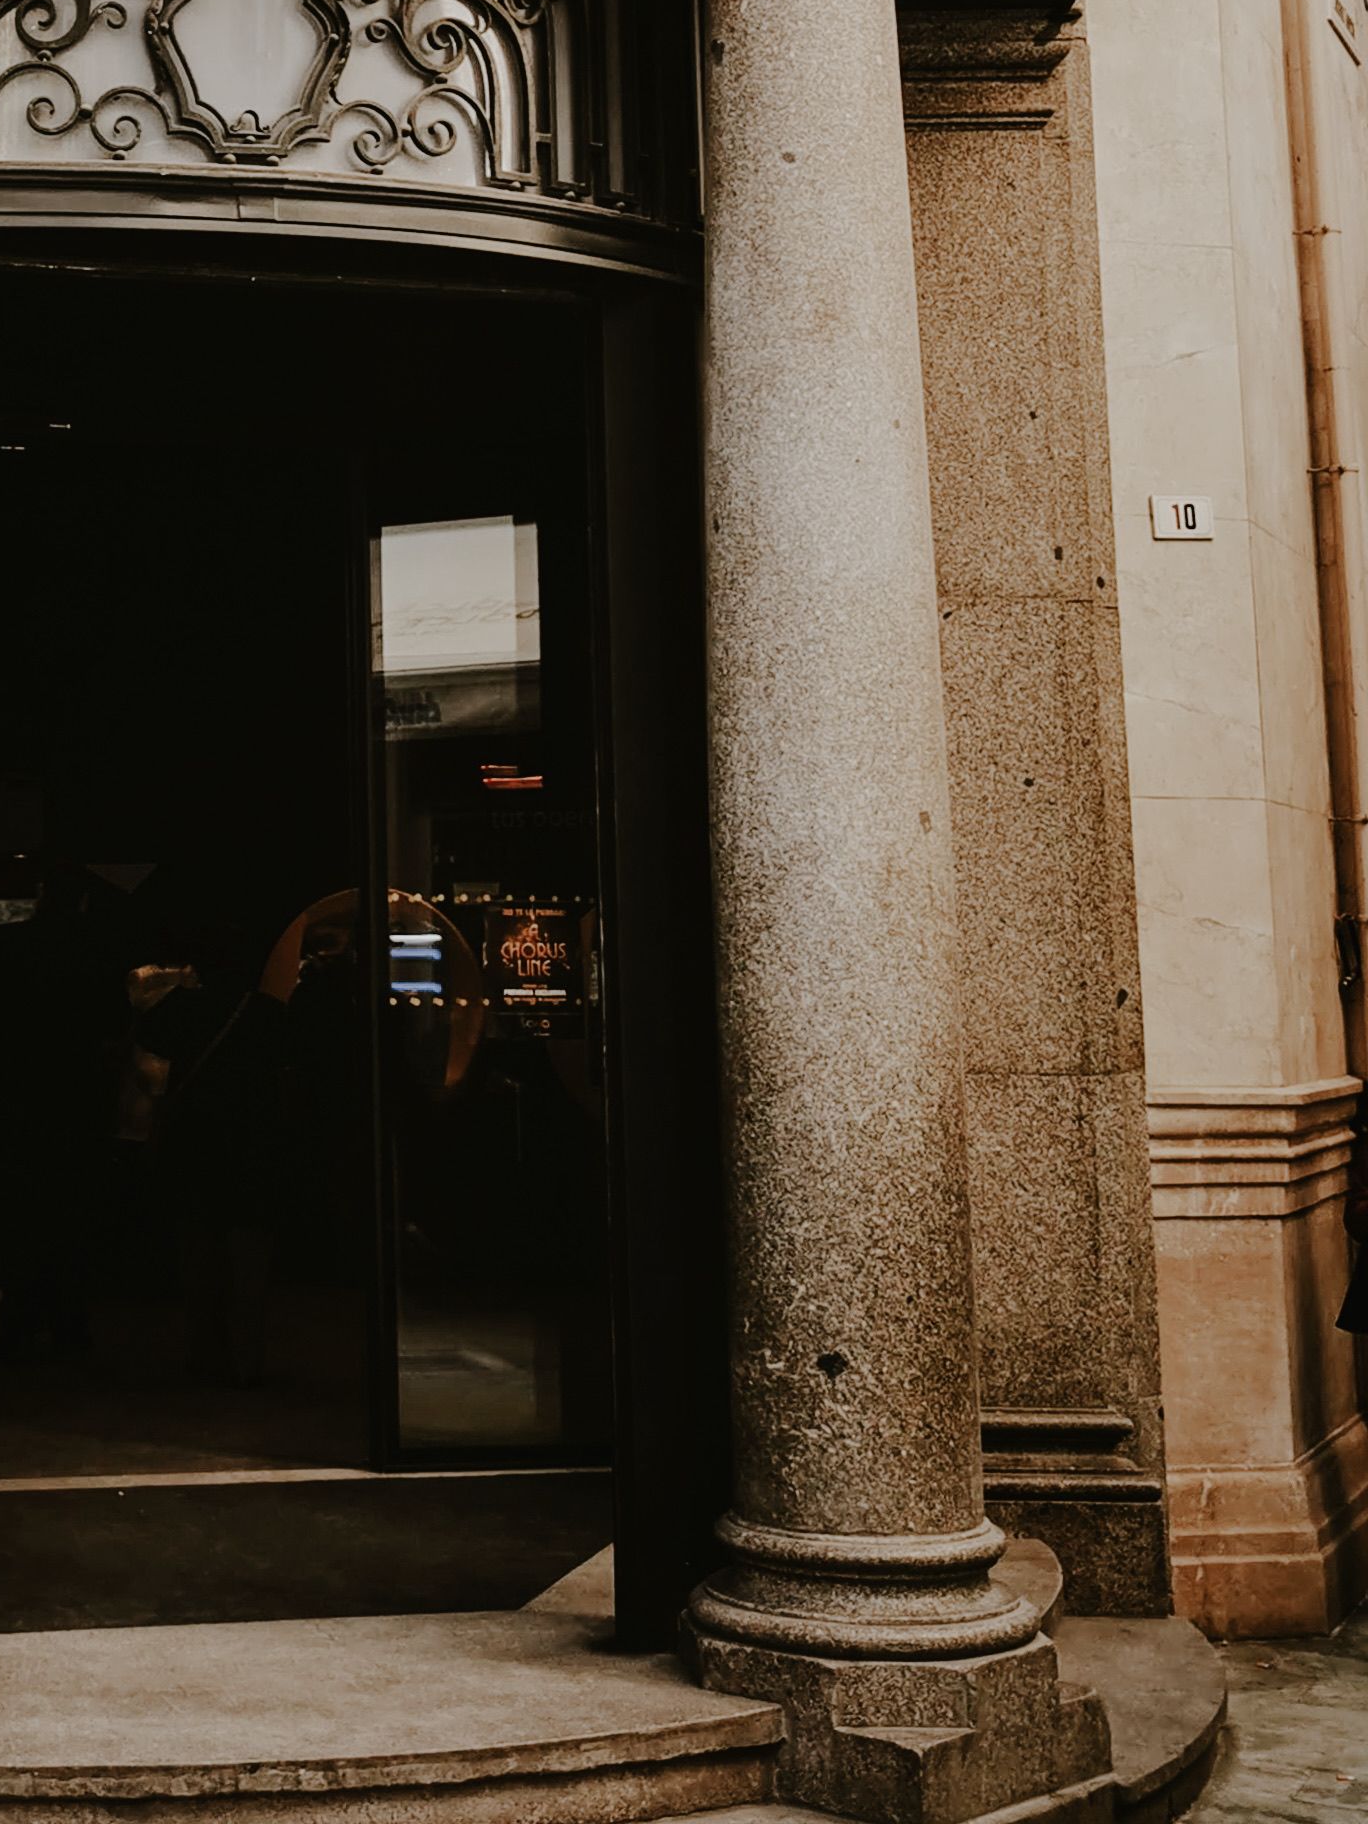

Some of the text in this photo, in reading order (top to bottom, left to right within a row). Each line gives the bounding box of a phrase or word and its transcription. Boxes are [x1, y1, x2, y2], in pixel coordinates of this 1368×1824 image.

[1171, 503, 1197, 530] 10
[500, 941, 567, 960] CHORUS
[516, 958, 552, 977] LINE
